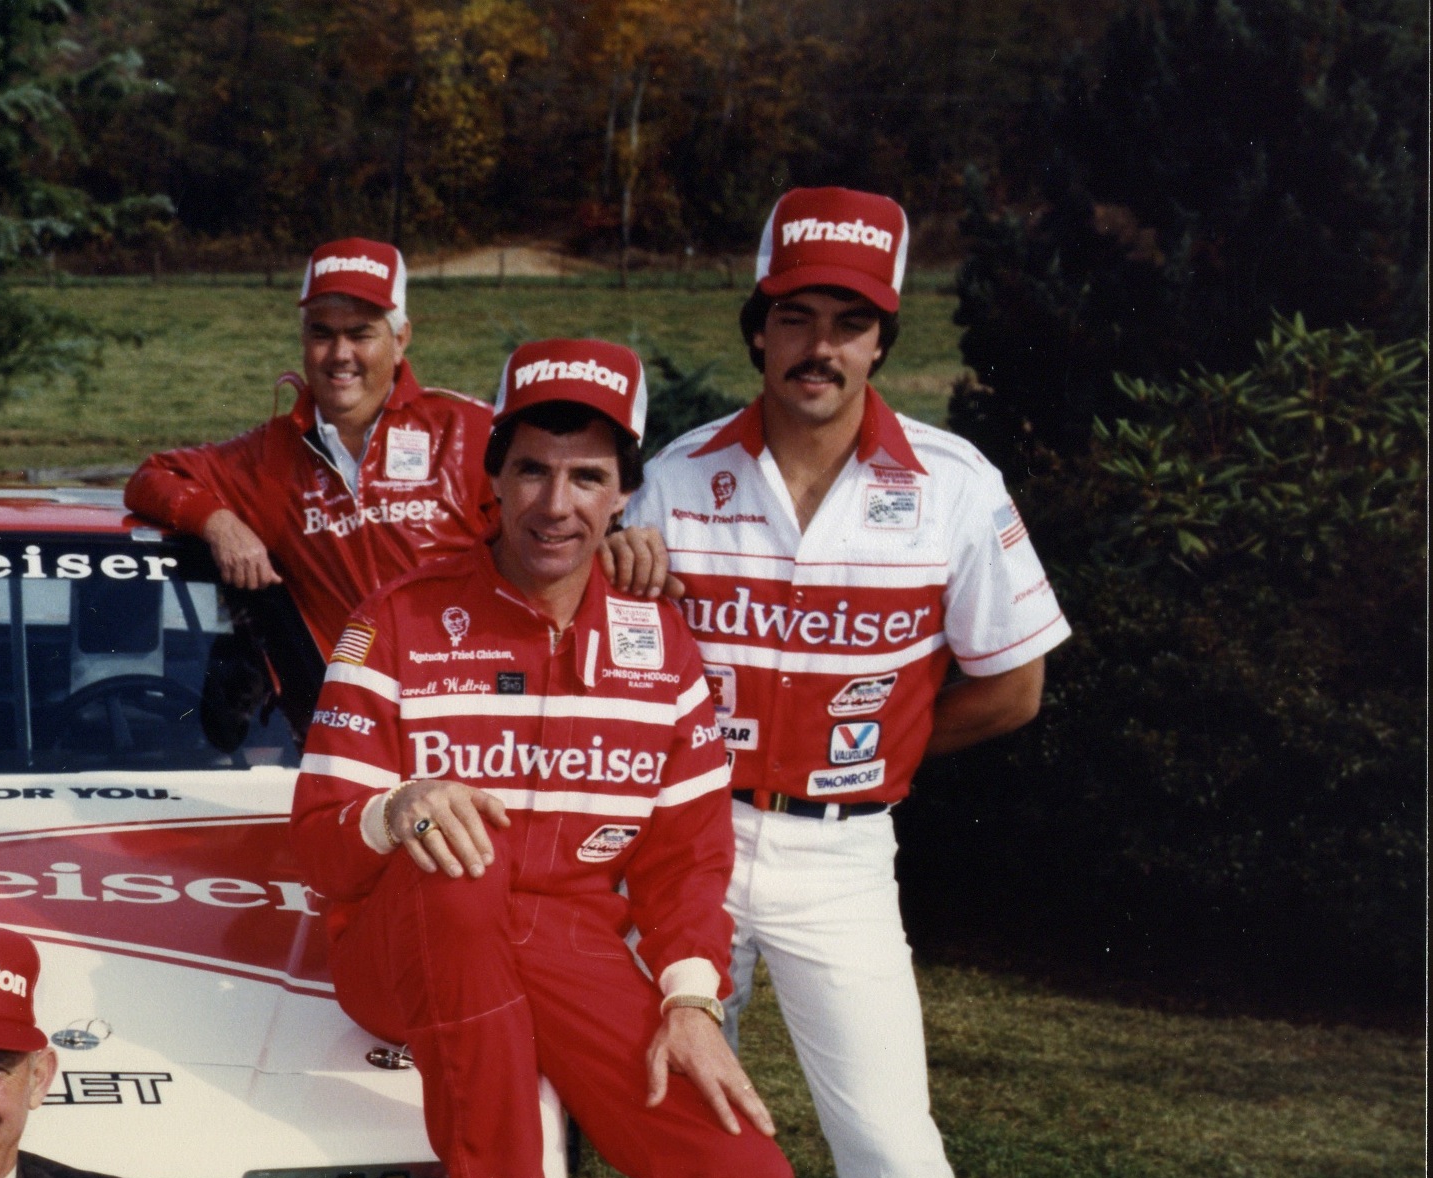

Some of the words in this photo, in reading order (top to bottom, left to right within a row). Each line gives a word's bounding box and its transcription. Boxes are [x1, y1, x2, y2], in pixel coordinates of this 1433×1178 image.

[782, 218, 893, 253] Winston
[315, 255, 389, 280] Winston
[515, 359, 628, 396] Winston
[683, 587, 930, 647] udweiser
[409, 650, 449, 664] Kentucky
[451, 649, 475, 660] Fried
[401, 681, 438, 696] arrell
[443, 677, 492, 696] Waltrip
[628, 681, 654, 689] RACING
[834, 746, 874, 761] VALVOLINE
[820, 768, 878, 788] MONROE
[68, 787, 182, 800] YOU.
